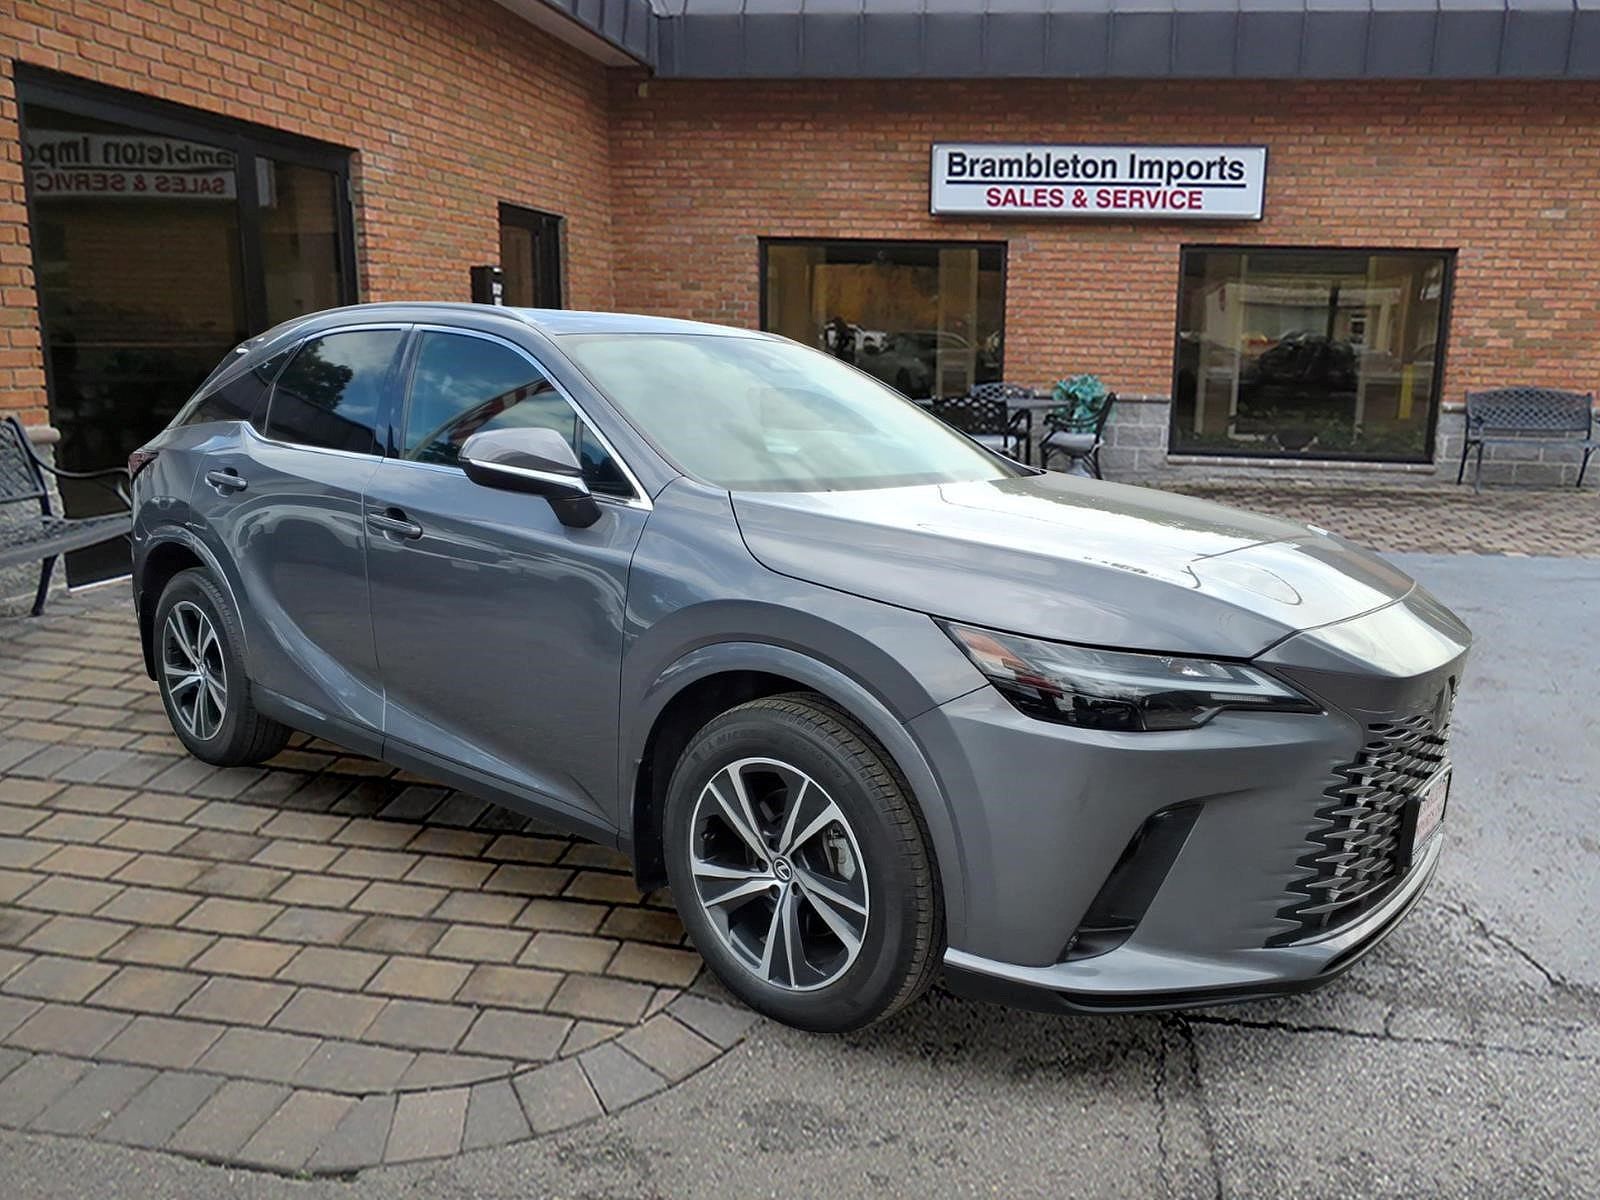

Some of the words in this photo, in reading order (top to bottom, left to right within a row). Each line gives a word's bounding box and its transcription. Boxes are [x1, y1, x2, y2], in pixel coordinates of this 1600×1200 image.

[948, 152, 1117, 178] Brambleton
[1129, 154, 1244, 186] Imports
[986, 187, 1063, 207] SALES
[1071, 189, 1087, 208] &
[1096, 190, 1202, 209] SERVICE
